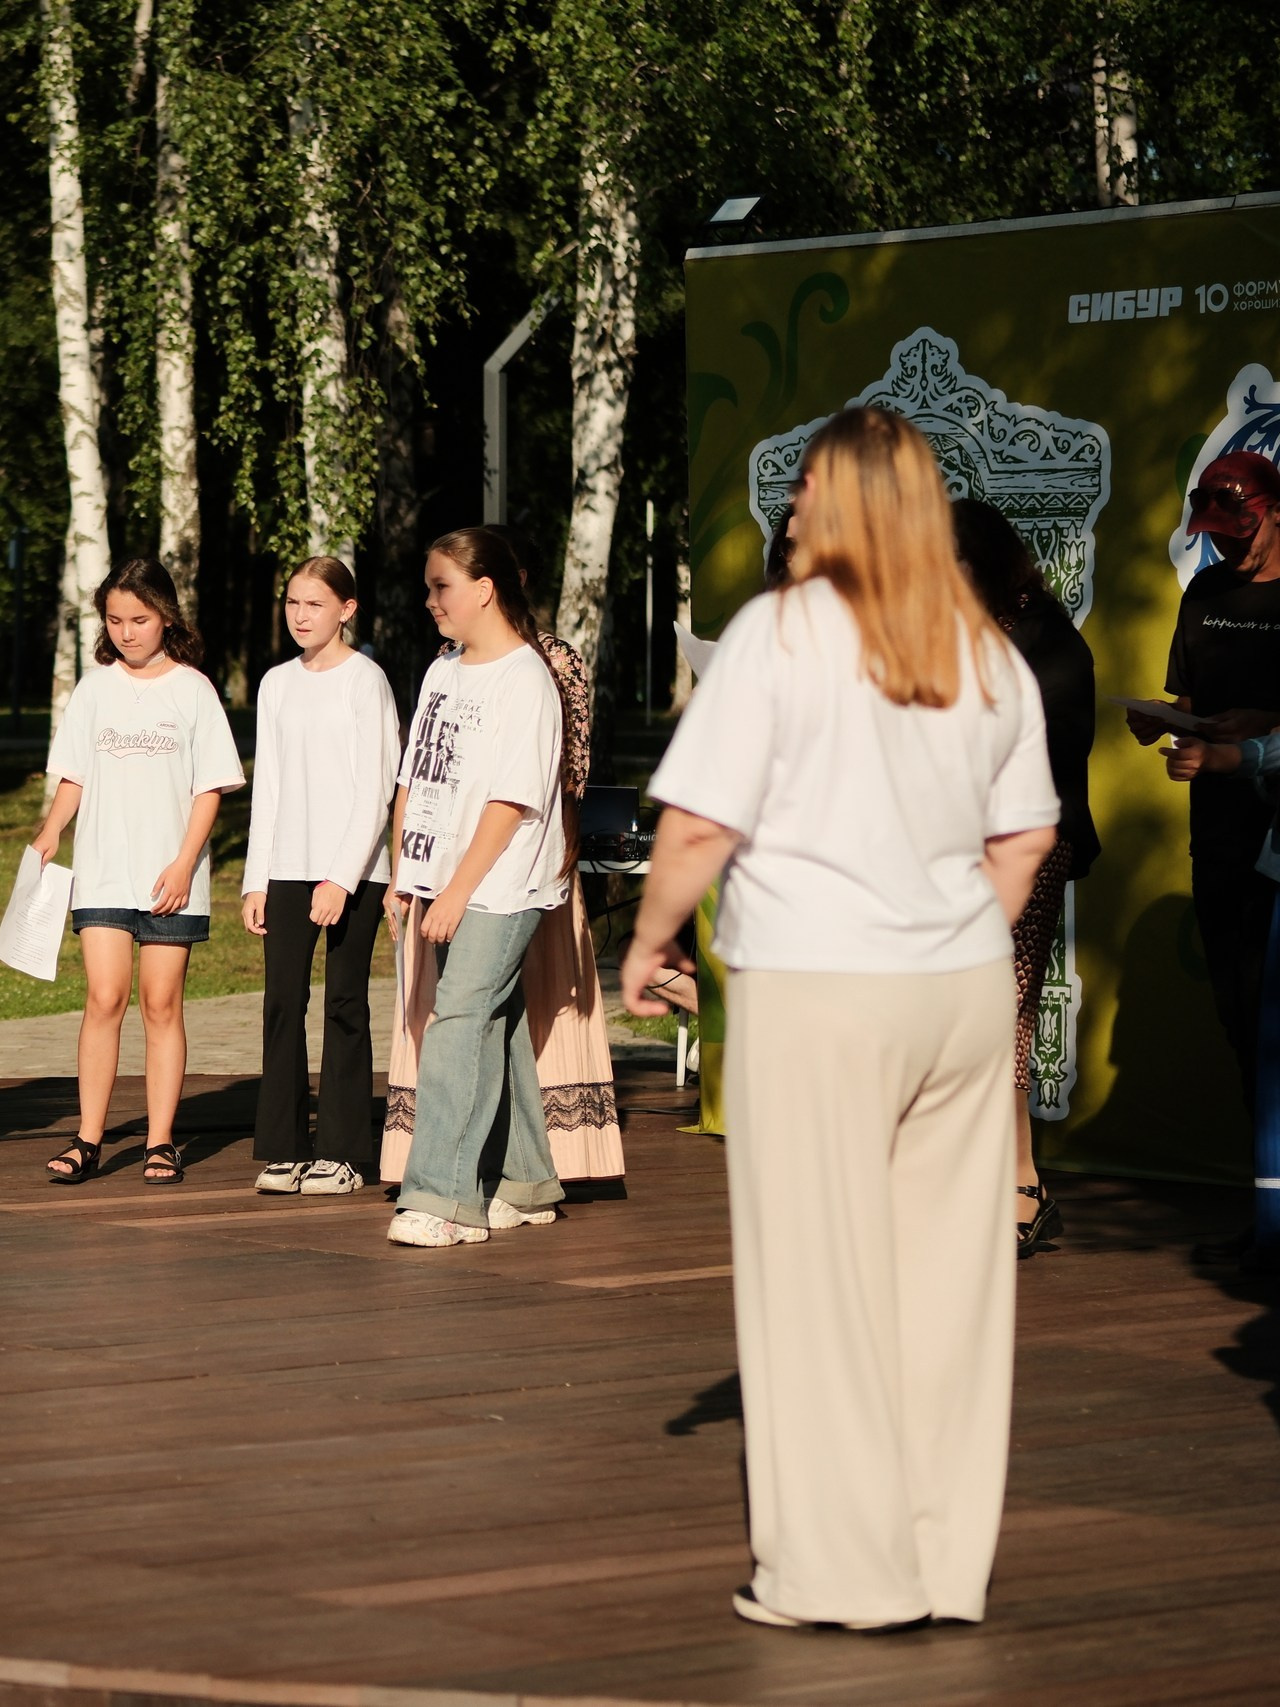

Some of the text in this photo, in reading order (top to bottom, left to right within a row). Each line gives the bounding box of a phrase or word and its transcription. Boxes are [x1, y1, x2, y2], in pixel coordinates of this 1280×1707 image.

[1194, 283, 1229, 314] 10
[1233, 280, 1280, 297] ФОРМ
[1067, 286, 1183, 324] СИБУР
[1233, 298, 1280, 311] ХОРОШИ
[422, 691, 448, 718] HE
[95, 728, 176, 757] Brooklyn
[416, 717, 460, 755] ULES
[401, 829, 436, 863] KEN
